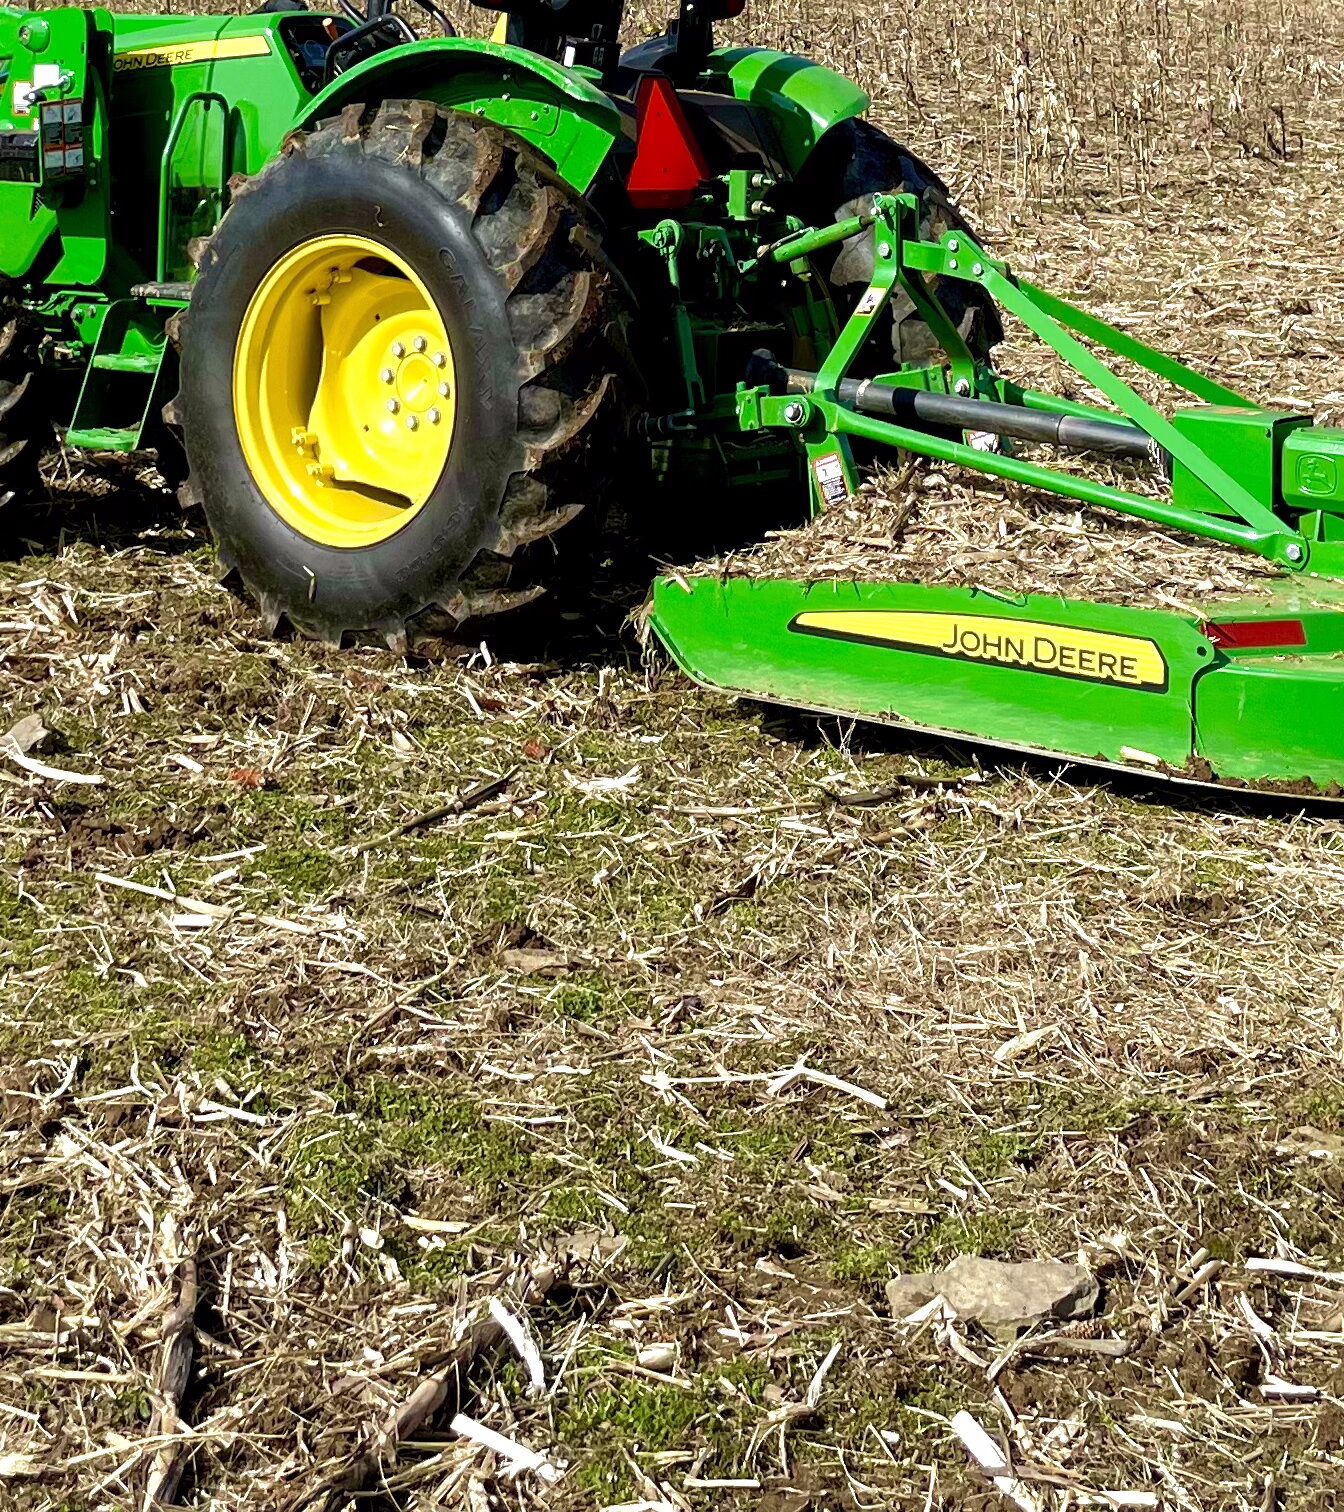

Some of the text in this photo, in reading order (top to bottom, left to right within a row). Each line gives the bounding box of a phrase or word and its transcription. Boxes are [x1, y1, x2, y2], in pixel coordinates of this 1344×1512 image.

[114, 49, 194, 70] OHN DEERE
[942, 623, 1138, 679] JOHN DEERE
